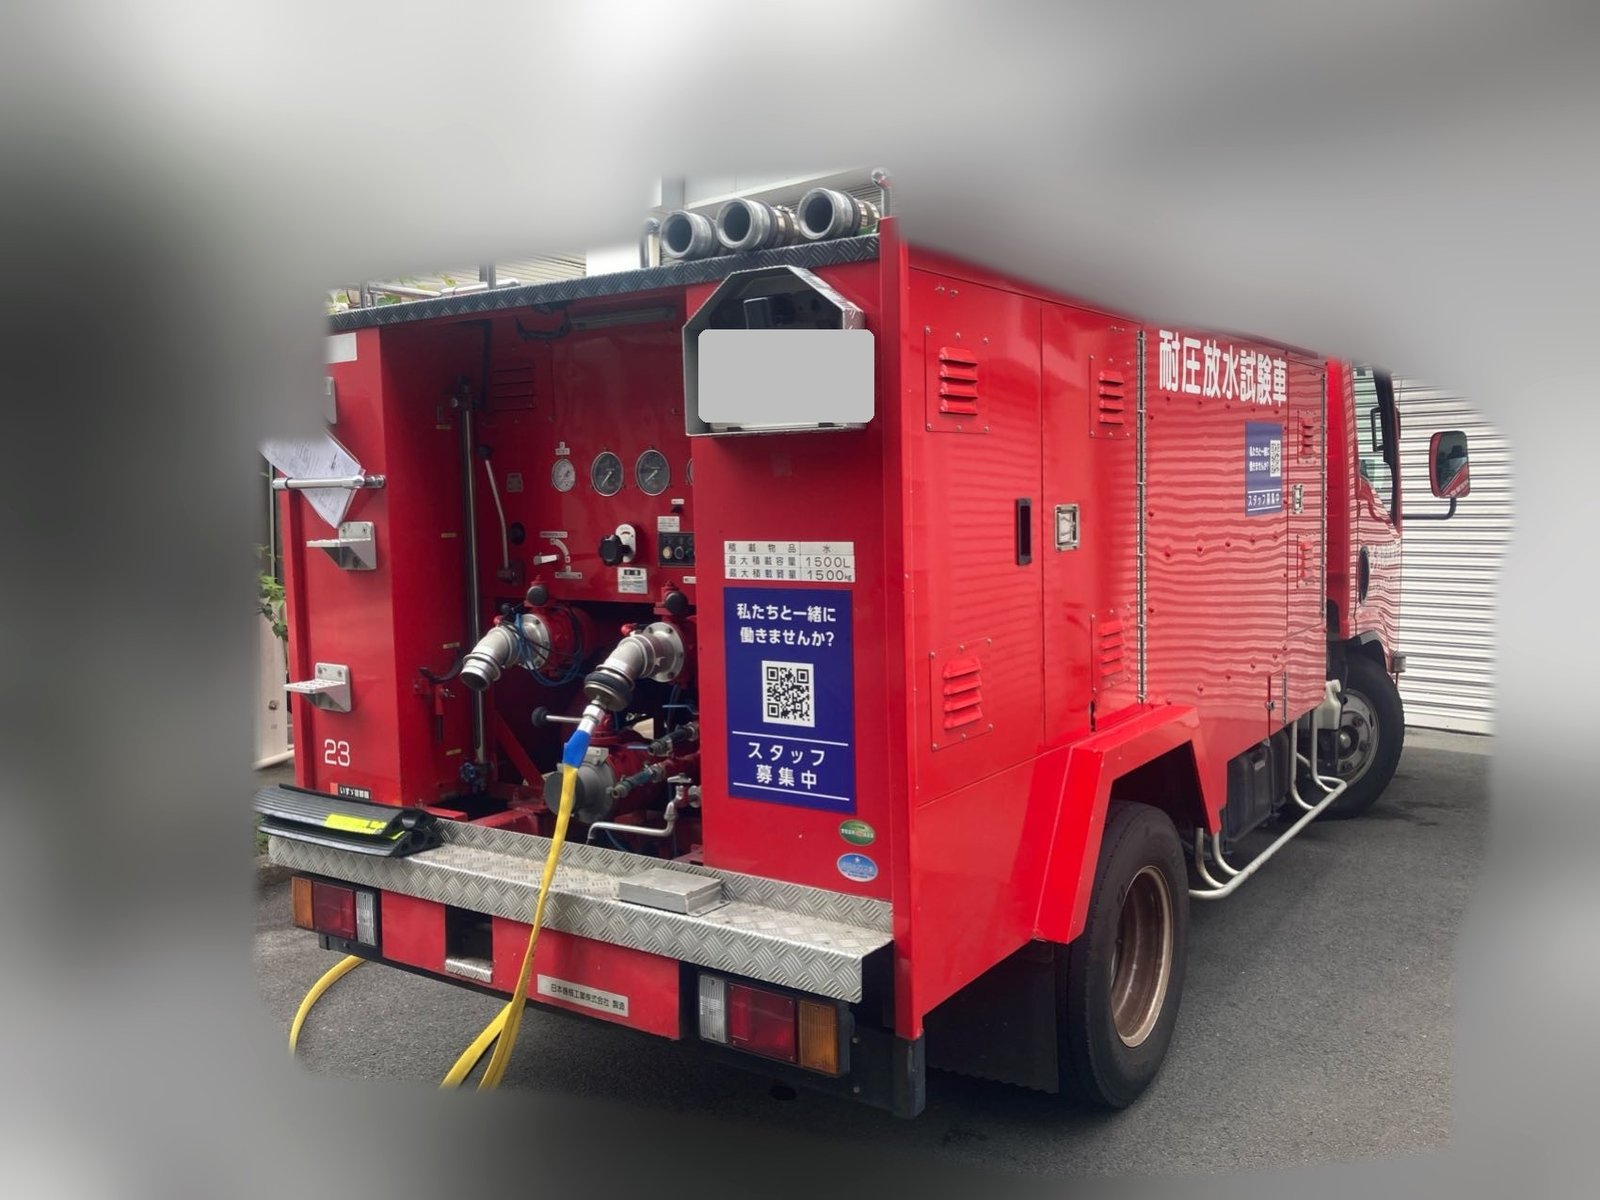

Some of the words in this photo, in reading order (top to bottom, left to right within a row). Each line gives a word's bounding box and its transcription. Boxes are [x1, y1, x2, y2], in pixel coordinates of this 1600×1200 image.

[1159, 329, 1287, 407] 耐圧放水試験車
[728, 543, 797, 553] 積載物品
[822, 544, 831, 554] 水
[728, 556, 796, 566] 最大積載容量
[805, 556, 851, 568] 1500L
[807, 569, 852, 581] 1500kg
[736, 603, 837, 623] 私たちと一緒に
[740, 626, 835, 647] 働きませんか?
[324, 738, 350, 767] 23
[748, 742, 825, 766] スタッフ
[756, 764, 817, 789] 募集中
